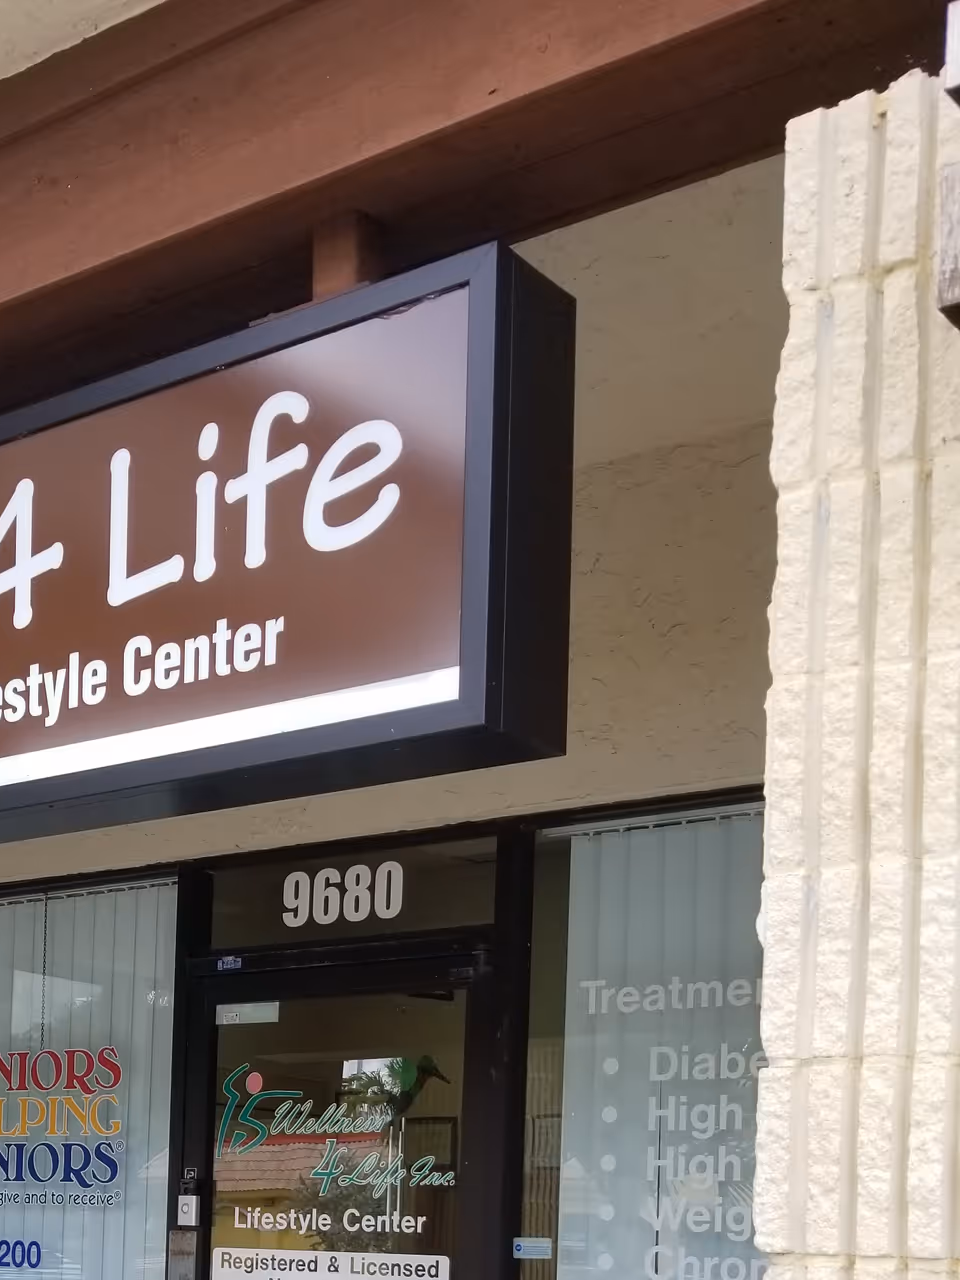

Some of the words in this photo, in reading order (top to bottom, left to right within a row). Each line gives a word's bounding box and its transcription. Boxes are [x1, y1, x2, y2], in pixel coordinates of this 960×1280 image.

[107, 390, 403, 607] Life
[123, 615, 284, 697] Center
[282, 860, 404, 928] 9680
[270, 1099, 385, 1136] Wellness
[647, 1094, 743, 1140] High
[310, 1138, 348, 1197] 4
[337, 1151, 408, 1199] Life
[409, 1156, 456, 1188] Inc.
[645, 1144, 741, 1190] High
[24, 1190, 47, 1205] and
[51, 1191, 65, 1206] to
[233, 1207, 331, 1235] Lifestyle
[342, 1208, 427, 1234] Center
[220, 1251, 319, 1274] Registered
[327, 1256, 340, 1274] &
[349, 1256, 440, 1279] Licensed
